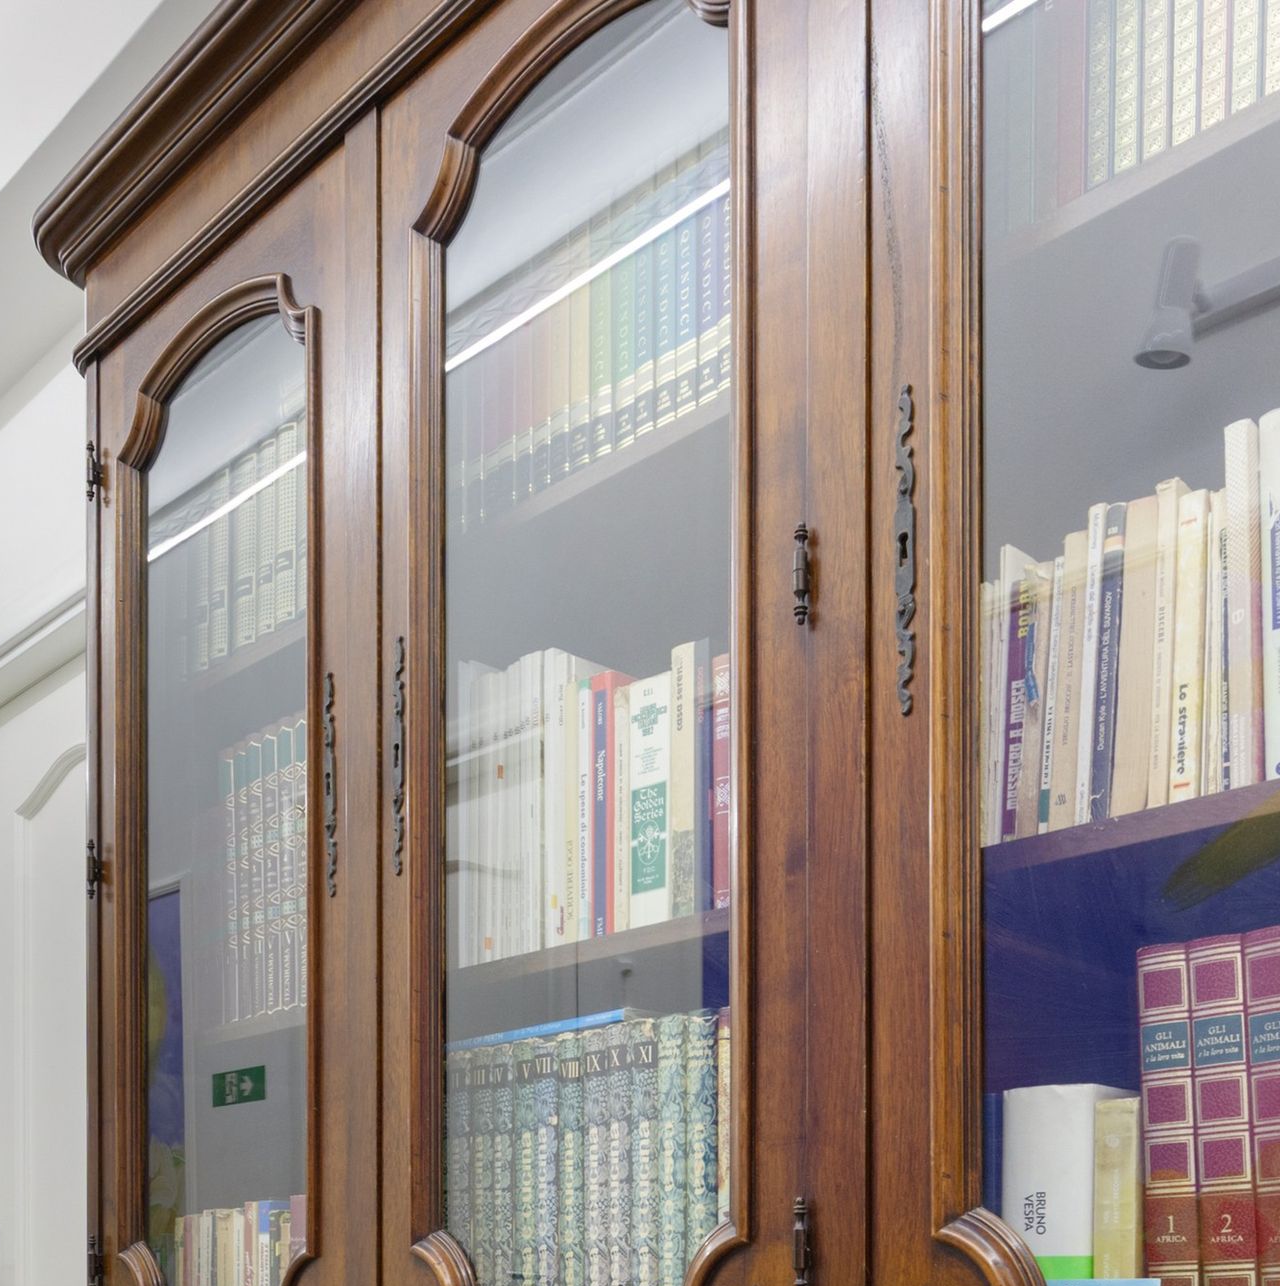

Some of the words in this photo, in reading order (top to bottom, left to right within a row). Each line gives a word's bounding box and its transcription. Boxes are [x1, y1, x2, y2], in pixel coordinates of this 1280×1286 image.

[702, 215, 713, 325] QUINDICI
[679, 229, 690, 336] QUINDICI
[659, 242, 670, 349] QUINDICI
[637, 254, 649, 359] QUINDICI
[1101, 629, 1111, 644] DEL
[1099, 647, 1110, 699] L'AVVENTURA
[1010, 678, 1026, 725] MOSCA
[1178, 684, 1189, 701] Lo
[676, 703, 684, 732] casa
[1098, 703, 1109, 720] Kyle
[1096, 722, 1106, 750] Duncan
[1176, 706, 1188, 776] straniero
[595, 750, 607, 803] Napoleone
[1006, 743, 1023, 811] MASSACRO
[639, 787, 659, 801] The
[578, 789, 588, 820] spese
[633, 796, 665, 813] Golden
[633, 807, 665, 825] Series
[580, 822, 588, 834] di
[579, 836, 588, 901] condominio
[566, 871, 575, 921] SCRIVERE
[1156, 1031, 1172, 1041] GLI
[1208, 1025, 1226, 1035] GLI
[1145, 1040, 1187, 1053] ANIMALI
[1197, 1033, 1240, 1047] ANIMALI
[1266, 1044, 1280, 1052] loro
[610, 1049, 621, 1067] X
[639, 1045, 653, 1063] XI
[1157, 1053, 1169, 1062] loro
[1170, 1052, 1185, 1060] vita
[1210, 1047, 1224, 1056] loro
[1224, 1046, 1239, 1054] vita
[522, 1063, 532, 1080] V
[535, 1056, 551, 1074] VII
[561, 1061, 580, 1078] VIII
[586, 1053, 600, 1073] IX
[1023, 1194, 1035, 1232] VESPA
[1035, 1191, 1047, 1236] BRUNO
[1166, 1214, 1176, 1233] 1
[1221, 1214, 1233, 1233] 2
[1156, 1235, 1187, 1244] AFRICA
[1210, 1234, 1244, 1244] AFRICA
